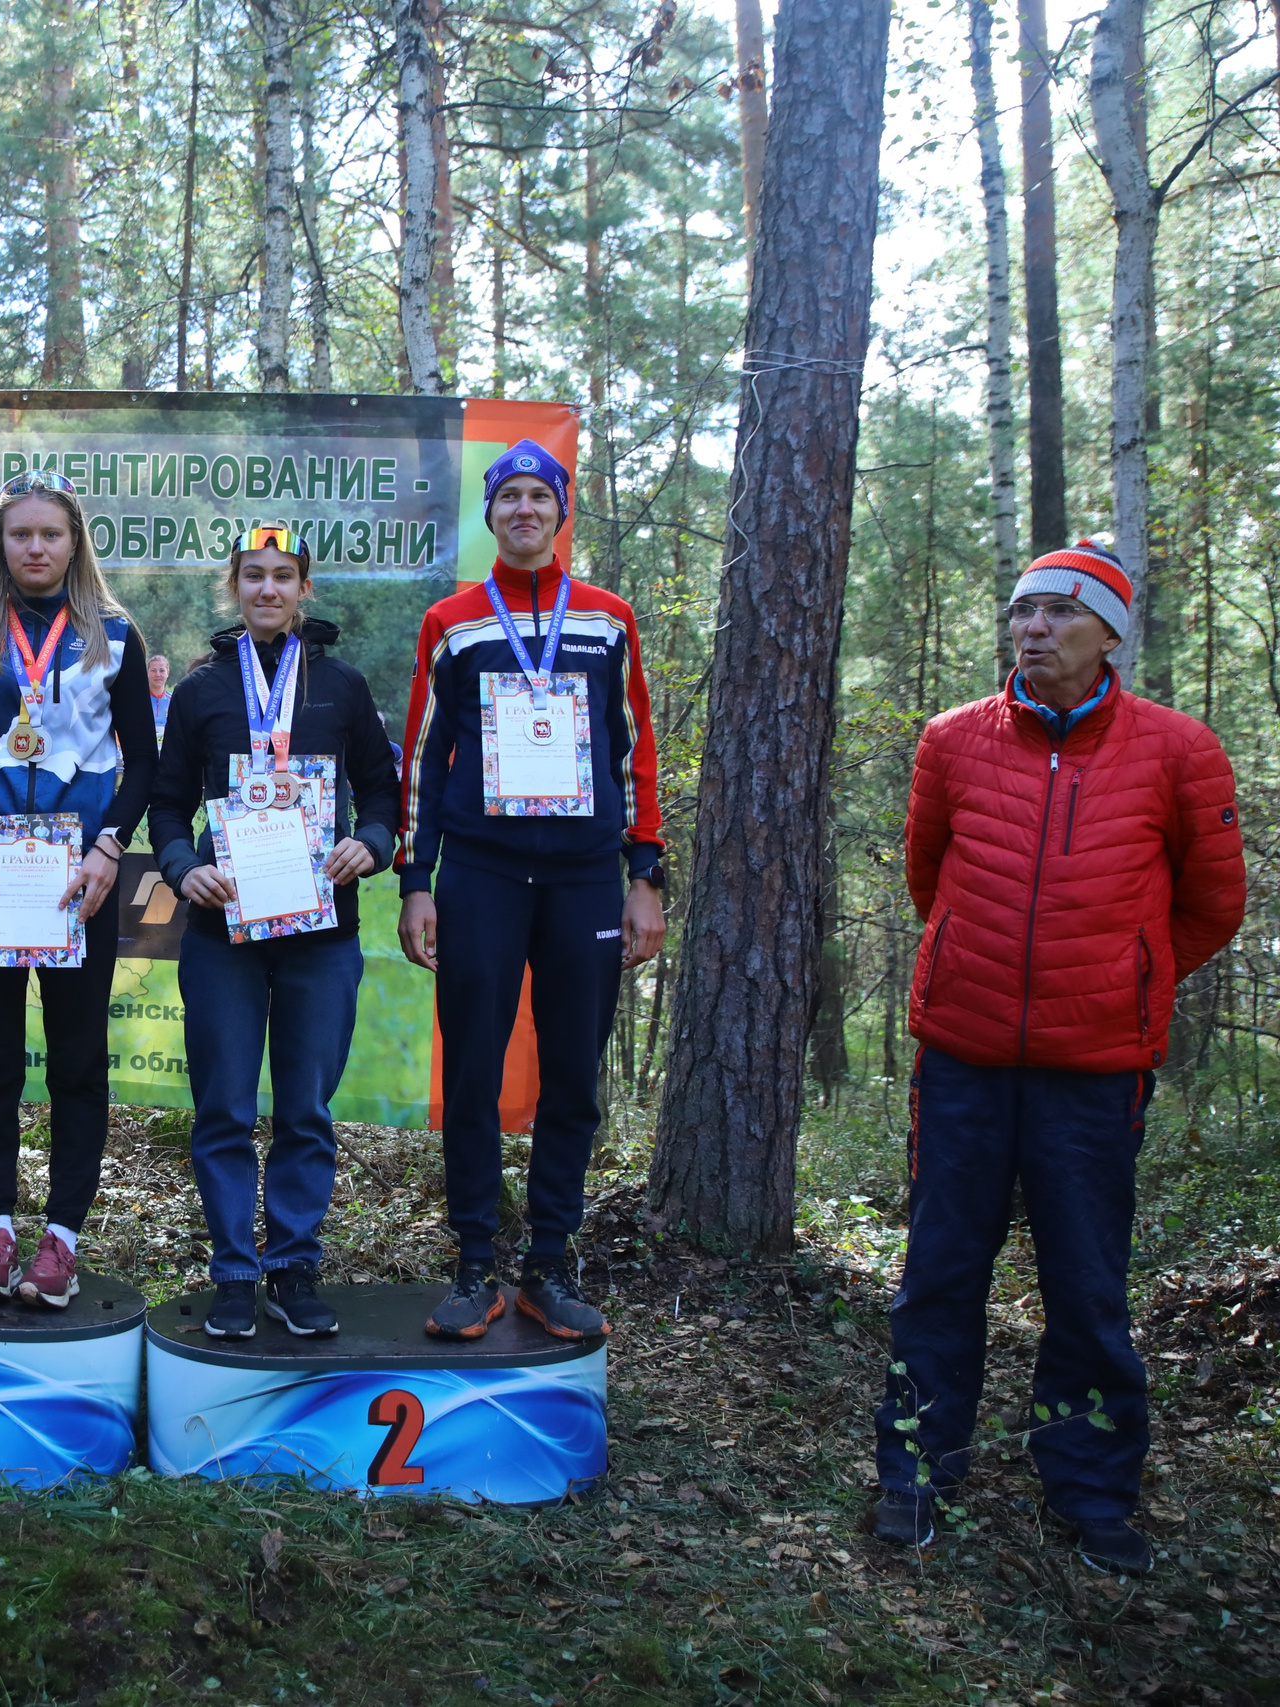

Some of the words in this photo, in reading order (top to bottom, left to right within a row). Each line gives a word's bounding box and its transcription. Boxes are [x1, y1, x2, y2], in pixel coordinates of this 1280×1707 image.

[489, 586, 505, 614] ОБЛАСТЬ
[500, 613, 527, 660] ЧЕЛЯБИНСКАЯ
[544, 627, 558, 658] ОБЛАСТЬ
[561, 643, 607, 656] КОМАНДА74
[240, 642, 250, 670] ОБЛАСТЬ
[276, 644, 295, 689] ЧЕЛЯБИНСКАЯ
[244, 671, 257, 720] ЧЕЛЯБИНСКАЯ
[267, 689, 281, 721] ОБЛАСТЬ
[505, 706, 565, 715] ГРАТА
[235, 820, 295, 838] ГРАМОТА
[1, 855, 60, 865] ГРАМОТА
[367, 1388, 425, 1487] 2
